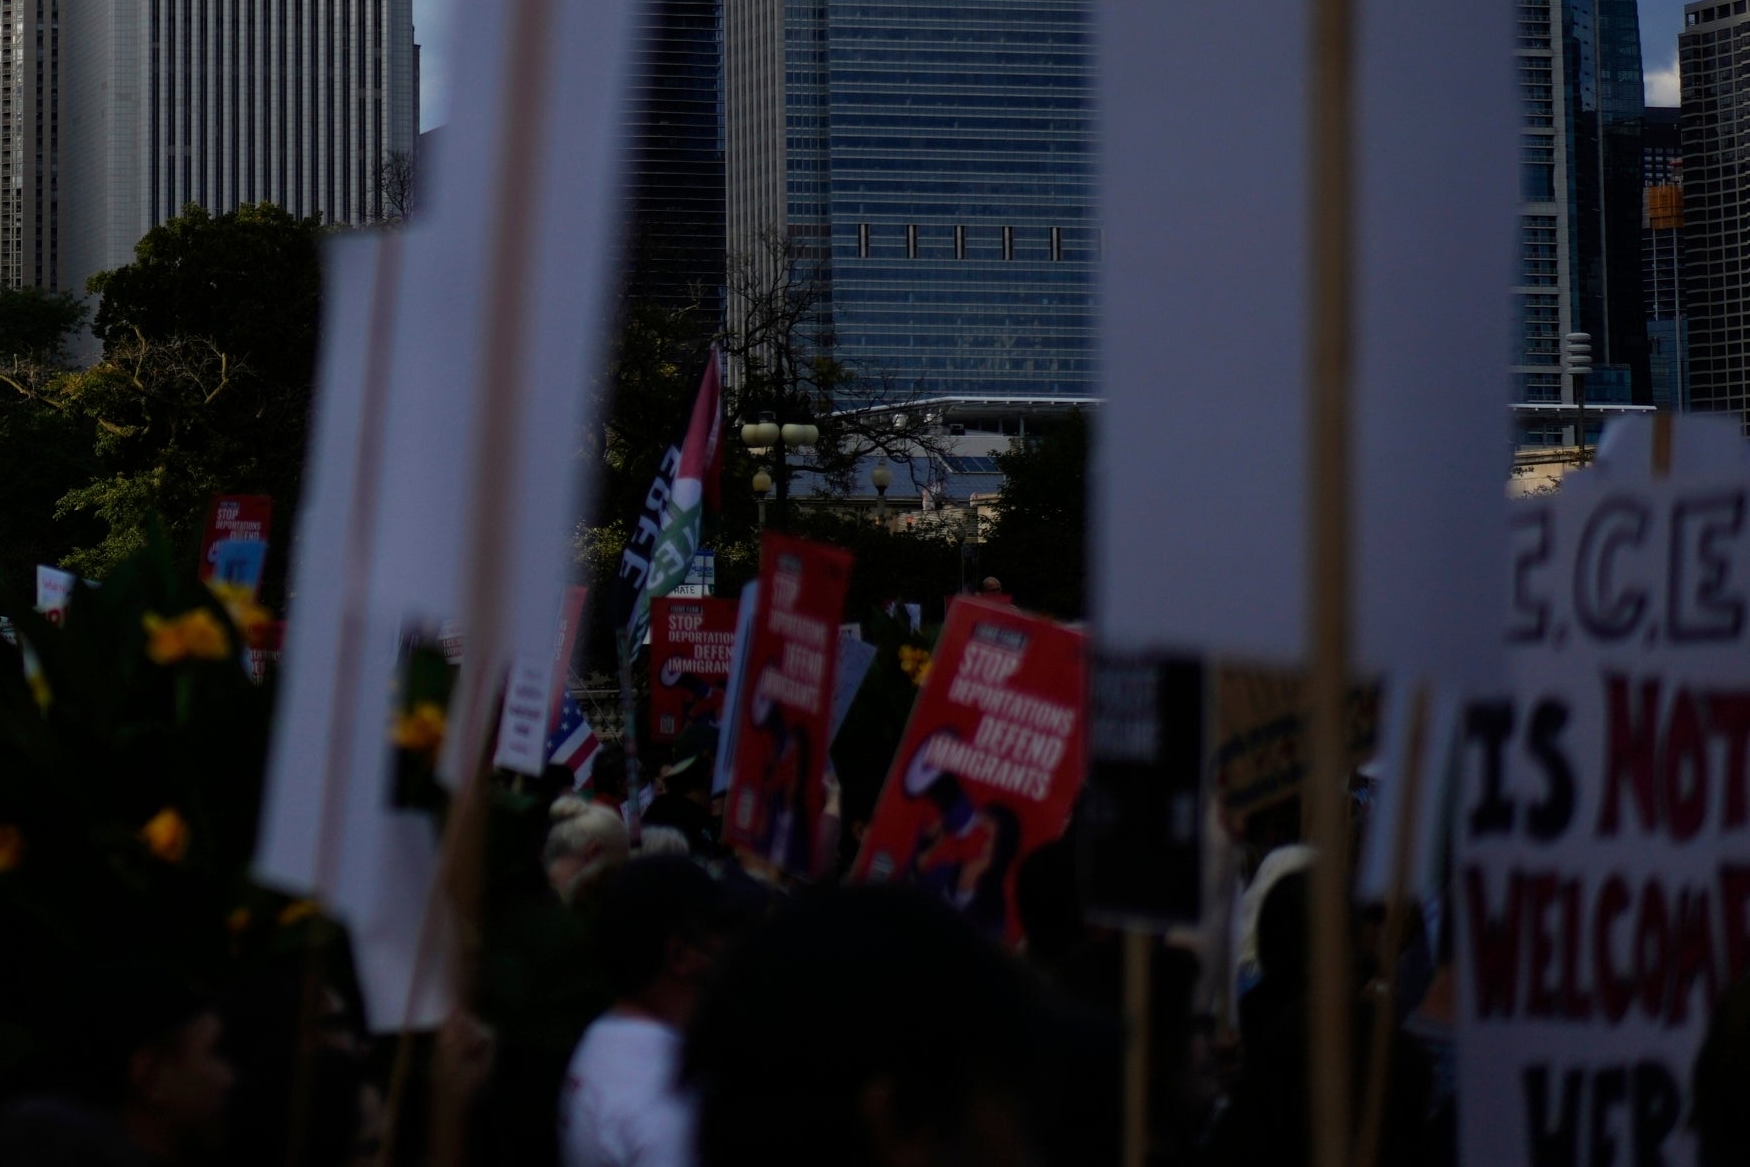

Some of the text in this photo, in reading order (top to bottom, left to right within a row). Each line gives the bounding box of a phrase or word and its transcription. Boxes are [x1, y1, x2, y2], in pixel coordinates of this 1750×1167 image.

[217, 509, 238, 520] STOP
[215, 520, 261, 531] DEPORTATIONS
[668, 615, 703, 630] STOP
[668, 631, 737, 643] DEPORTATION
[694, 644, 732, 660] DEFEN
[668, 659, 731, 673] IMMIGRAN
[959, 640, 1024, 682] STOP
[947, 675, 1077, 737] DEPORTATIONS
[973, 714, 1065, 772] DEFEND
[1465, 696, 1575, 839] IS
[1600, 672, 1750, 840] NOT
[924, 732, 1051, 802] IMMIGRANTS
